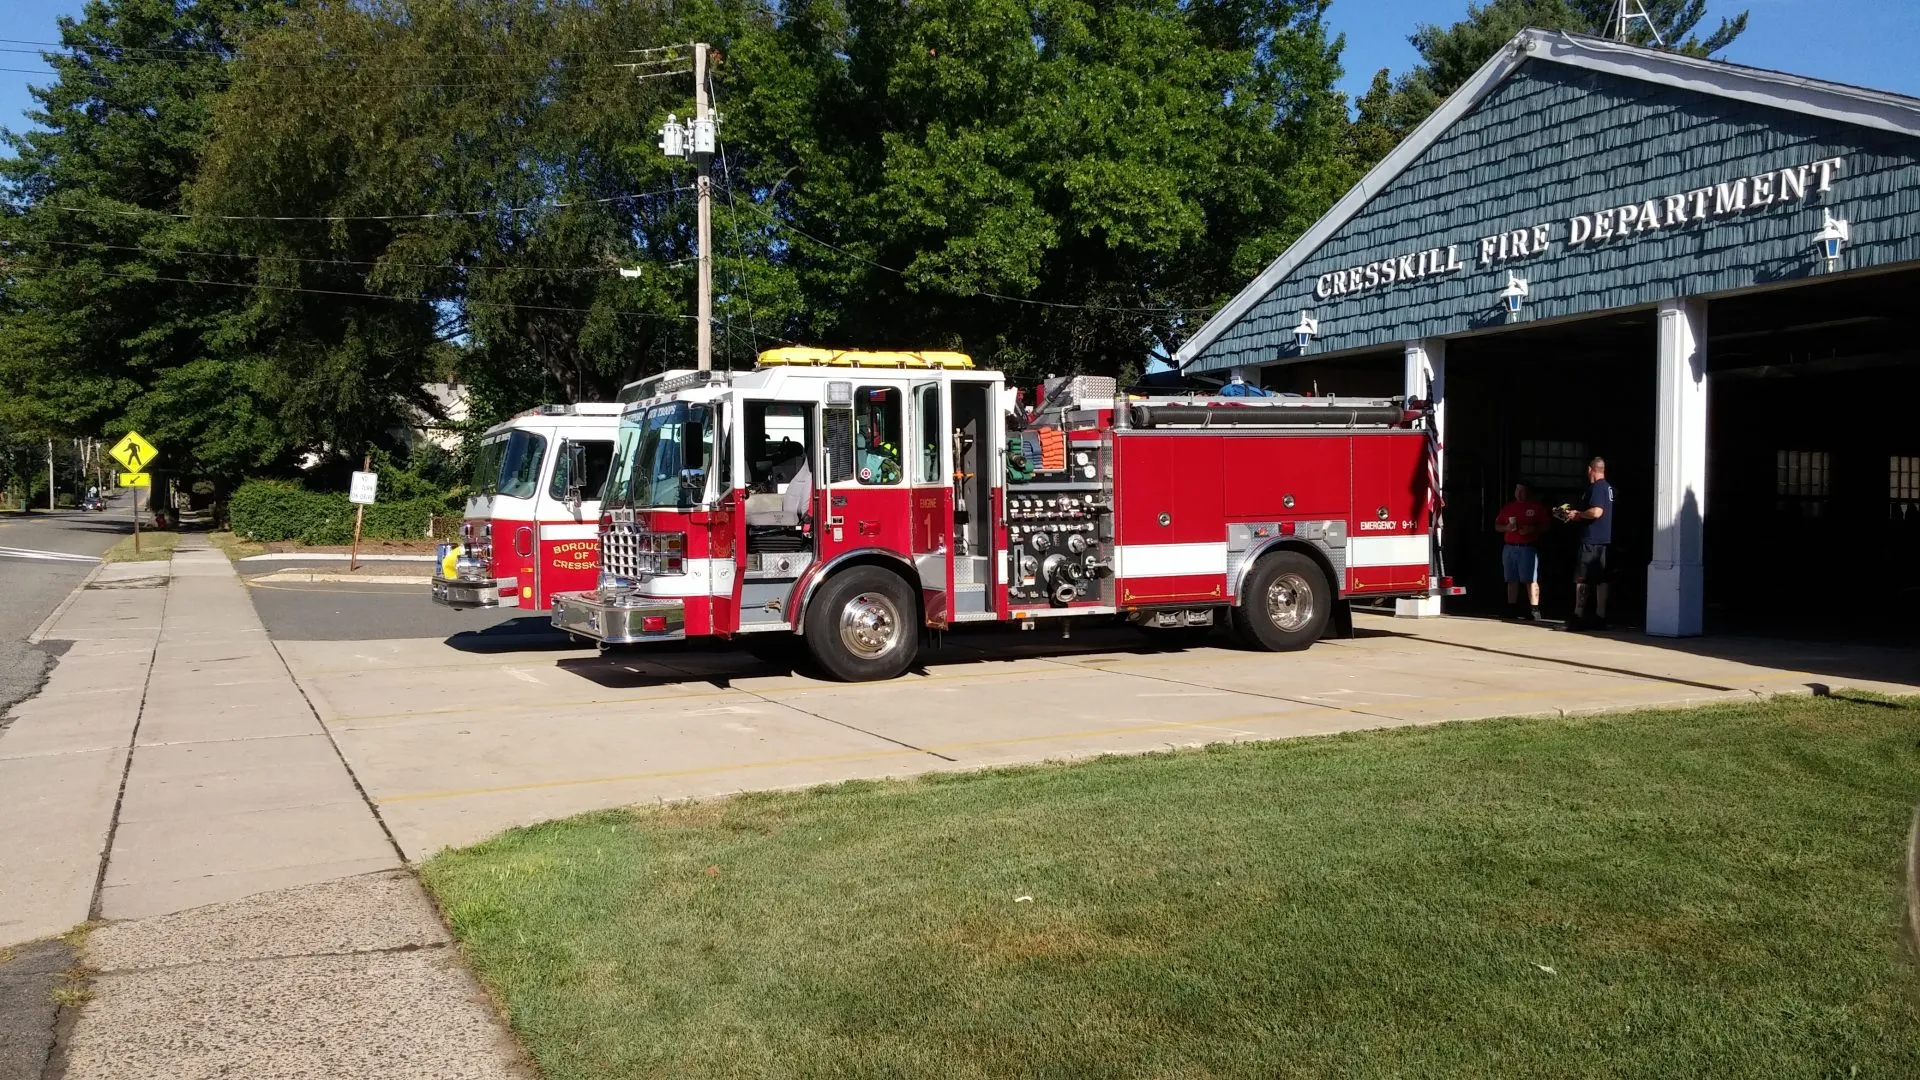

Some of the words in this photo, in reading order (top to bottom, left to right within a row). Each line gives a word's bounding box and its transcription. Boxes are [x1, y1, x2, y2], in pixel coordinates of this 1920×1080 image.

[1316, 244, 1463, 298] CRESSKILL
[1479, 223, 1550, 264] FIRE
[1567, 157, 1841, 246] DEPARTMENT
[924, 513, 932, 549] 1
[1360, 520, 1397, 530] EMERGENCY
[1402, 520, 1418, 529] 9-1-1
[574, 552, 589, 560] OF
